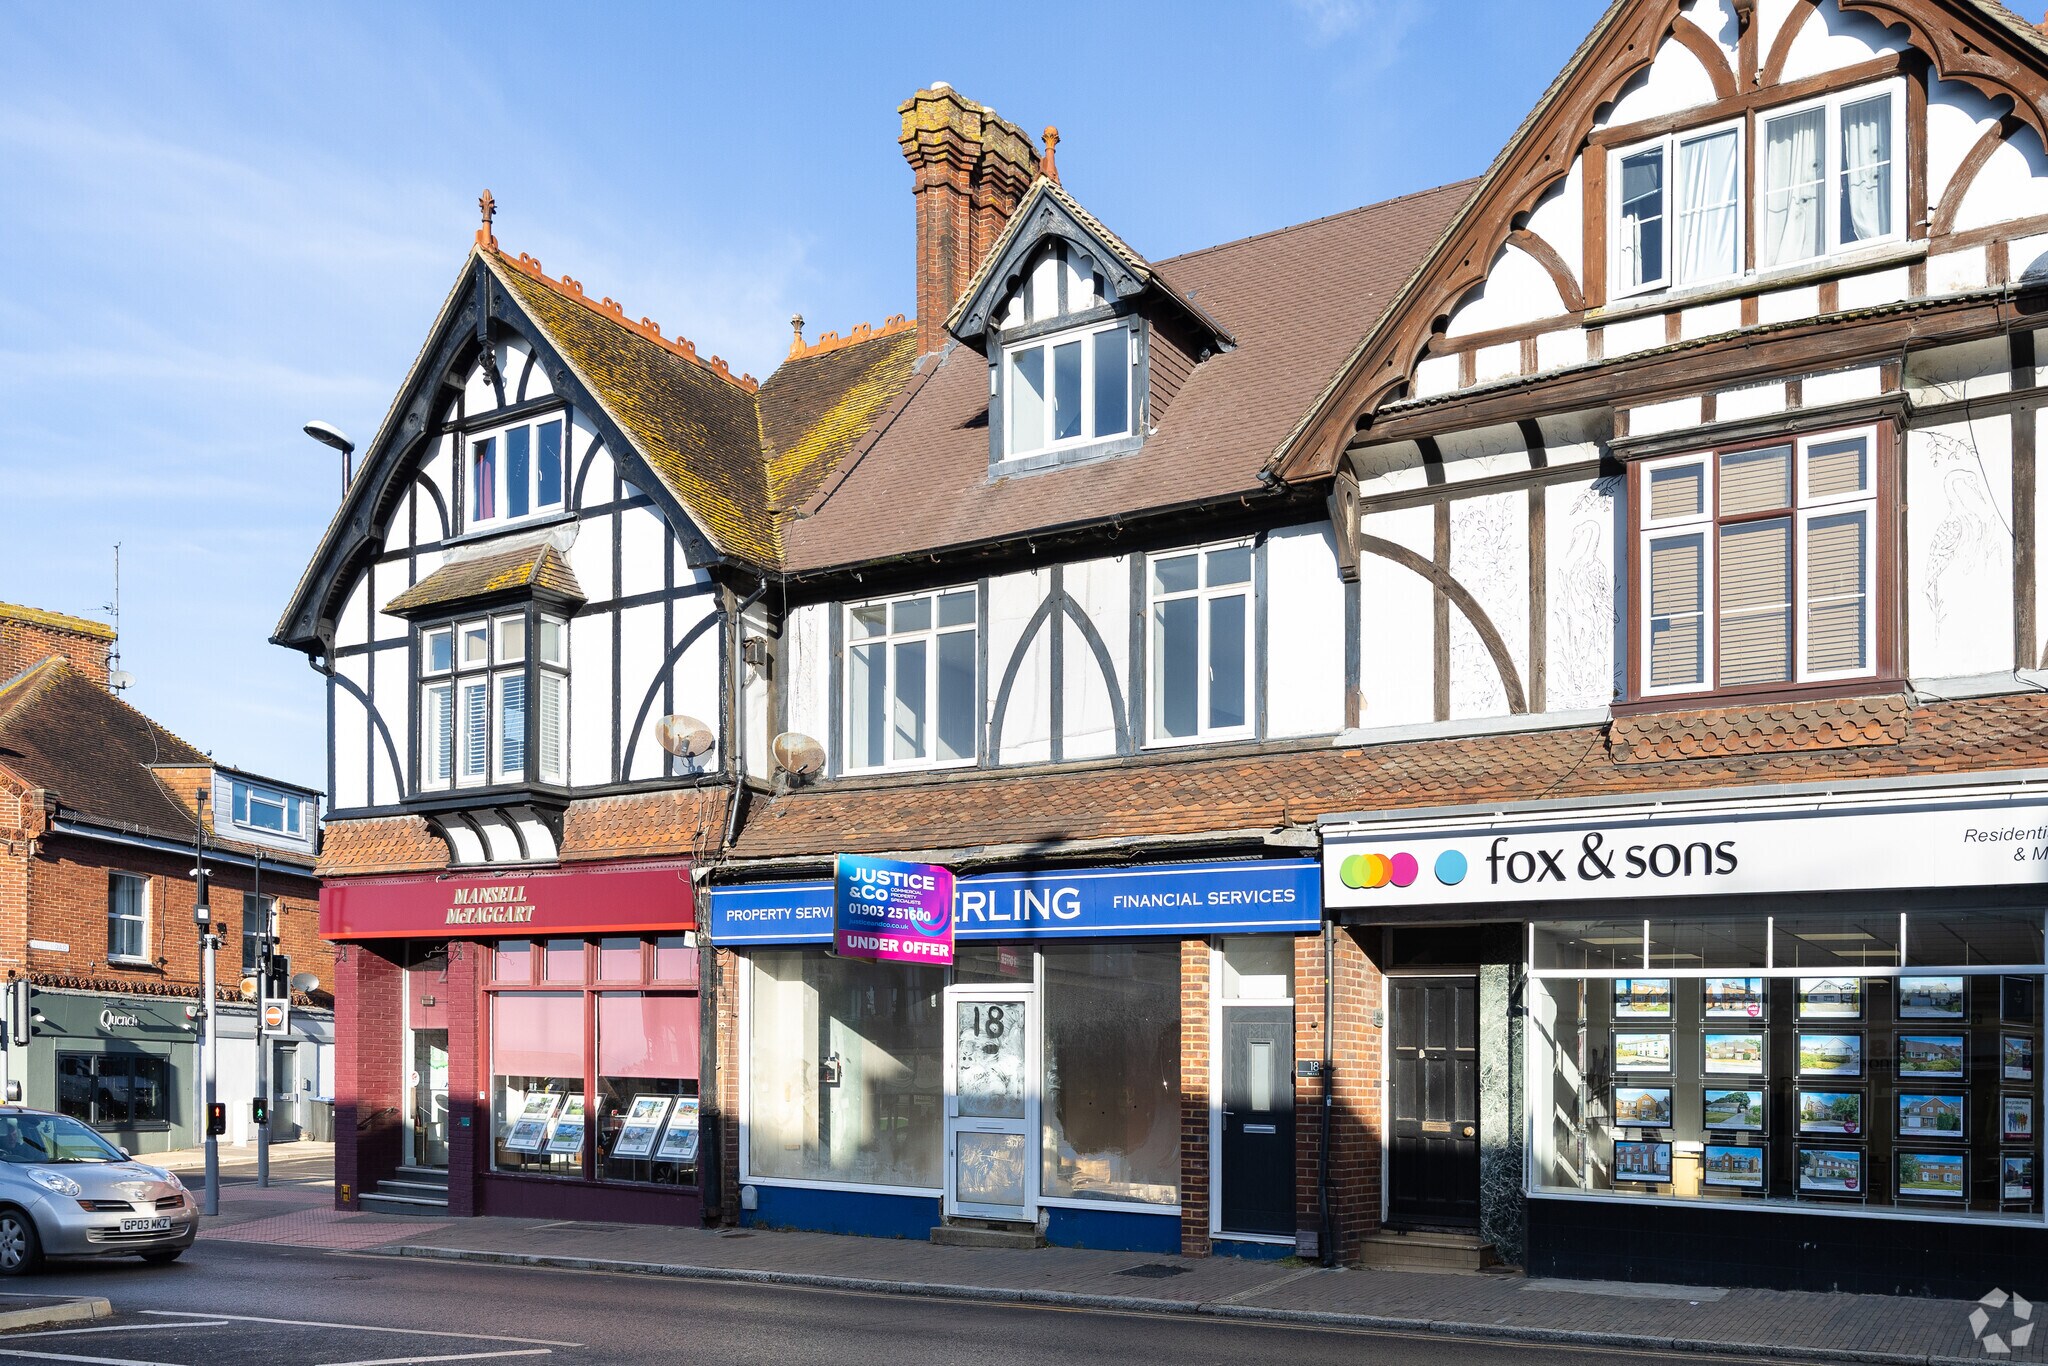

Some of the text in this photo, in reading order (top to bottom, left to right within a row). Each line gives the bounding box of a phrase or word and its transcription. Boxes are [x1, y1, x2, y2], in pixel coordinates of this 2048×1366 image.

[1964, 825, 2048, 843] Residenti
[1485, 832, 1738, 884] fox & sons
[2013, 847, 2026, 861] &
[849, 868, 935, 891] JUSTICE
[453, 886, 527, 905] MANSELL
[849, 884, 888, 902] &Co
[1113, 888, 1296, 908] FINANCIAL SERVICES
[445, 905, 535, 924] McTAGGART
[726, 906, 833, 921] PROPERTY SERVI
[849, 903, 931, 922] 01903 251600
[955, 887, 1080, 923] RLING
[847, 935, 949, 957] UNDER OFFER
[974, 1006, 1004, 1039] 18
[1309, 1061, 1320, 1071] 18
[124, 1218, 168, 1230] GP03 MKZ
